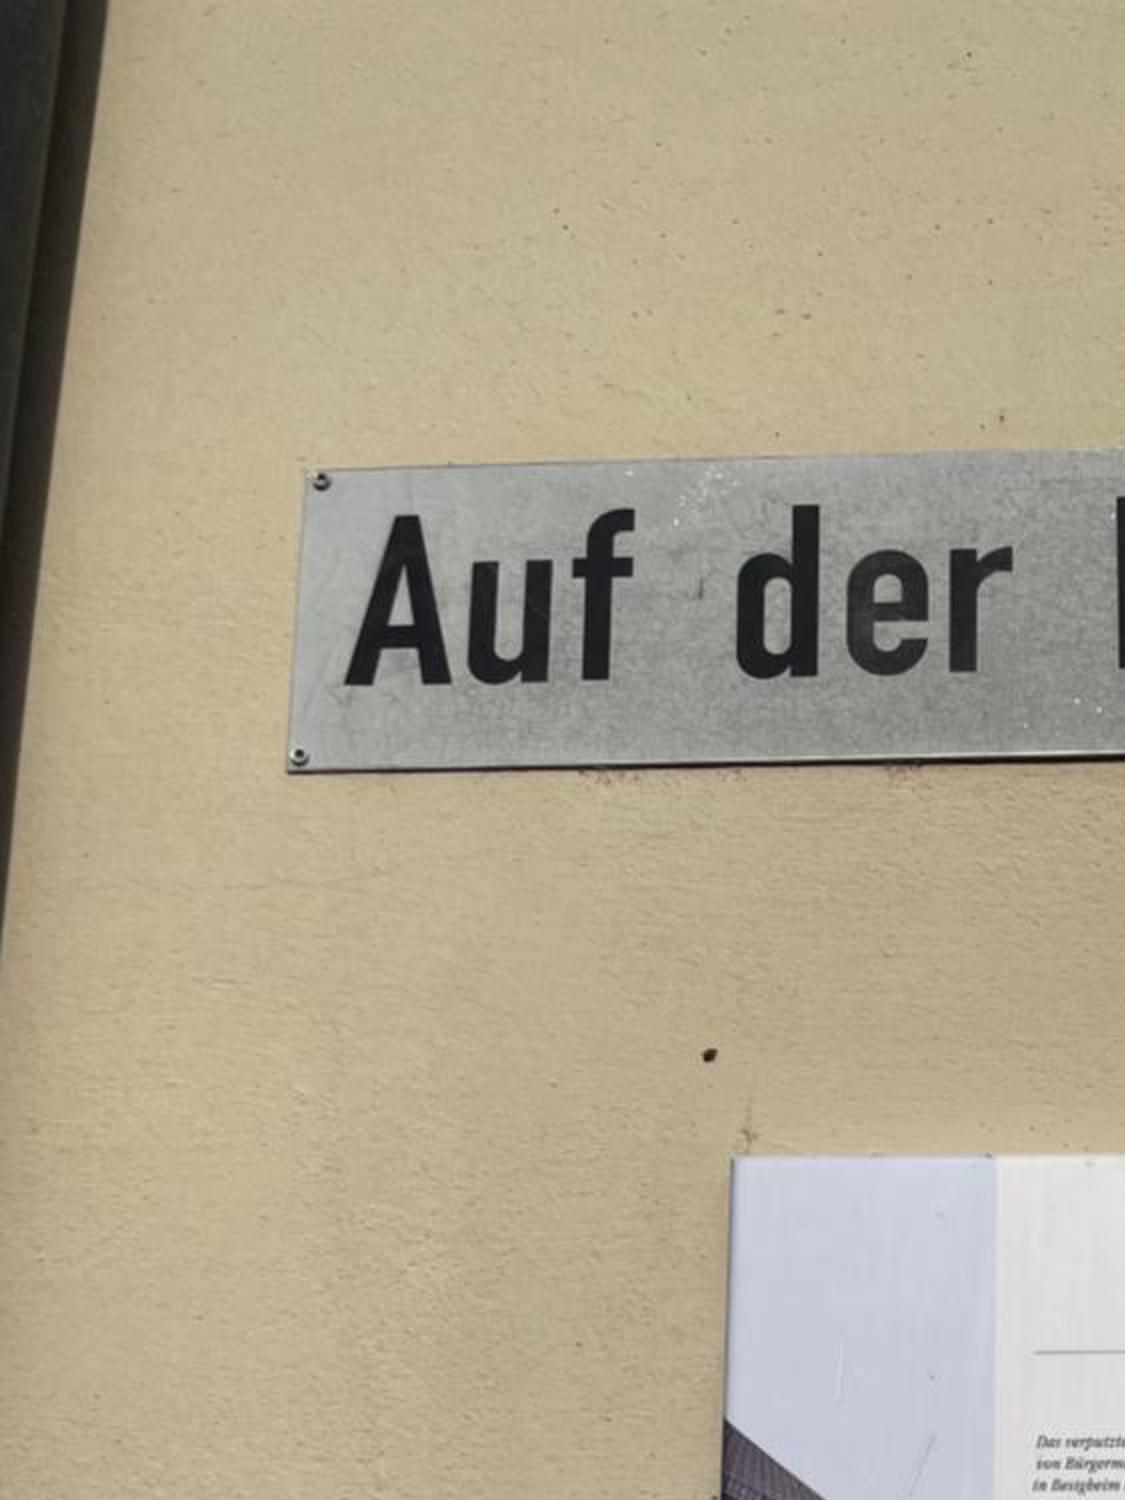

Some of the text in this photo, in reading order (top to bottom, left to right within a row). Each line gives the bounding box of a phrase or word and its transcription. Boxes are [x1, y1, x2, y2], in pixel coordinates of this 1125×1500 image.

[344, 508, 636, 687] Auf
[736, 504, 1014, 681] der
[1035, 1434, 1062, 1449] Das
[1036, 1456, 1062, 1471] von
[1032, 1478, 1048, 1492] in
[1050, 1476, 1121, 1496] Besigheim
